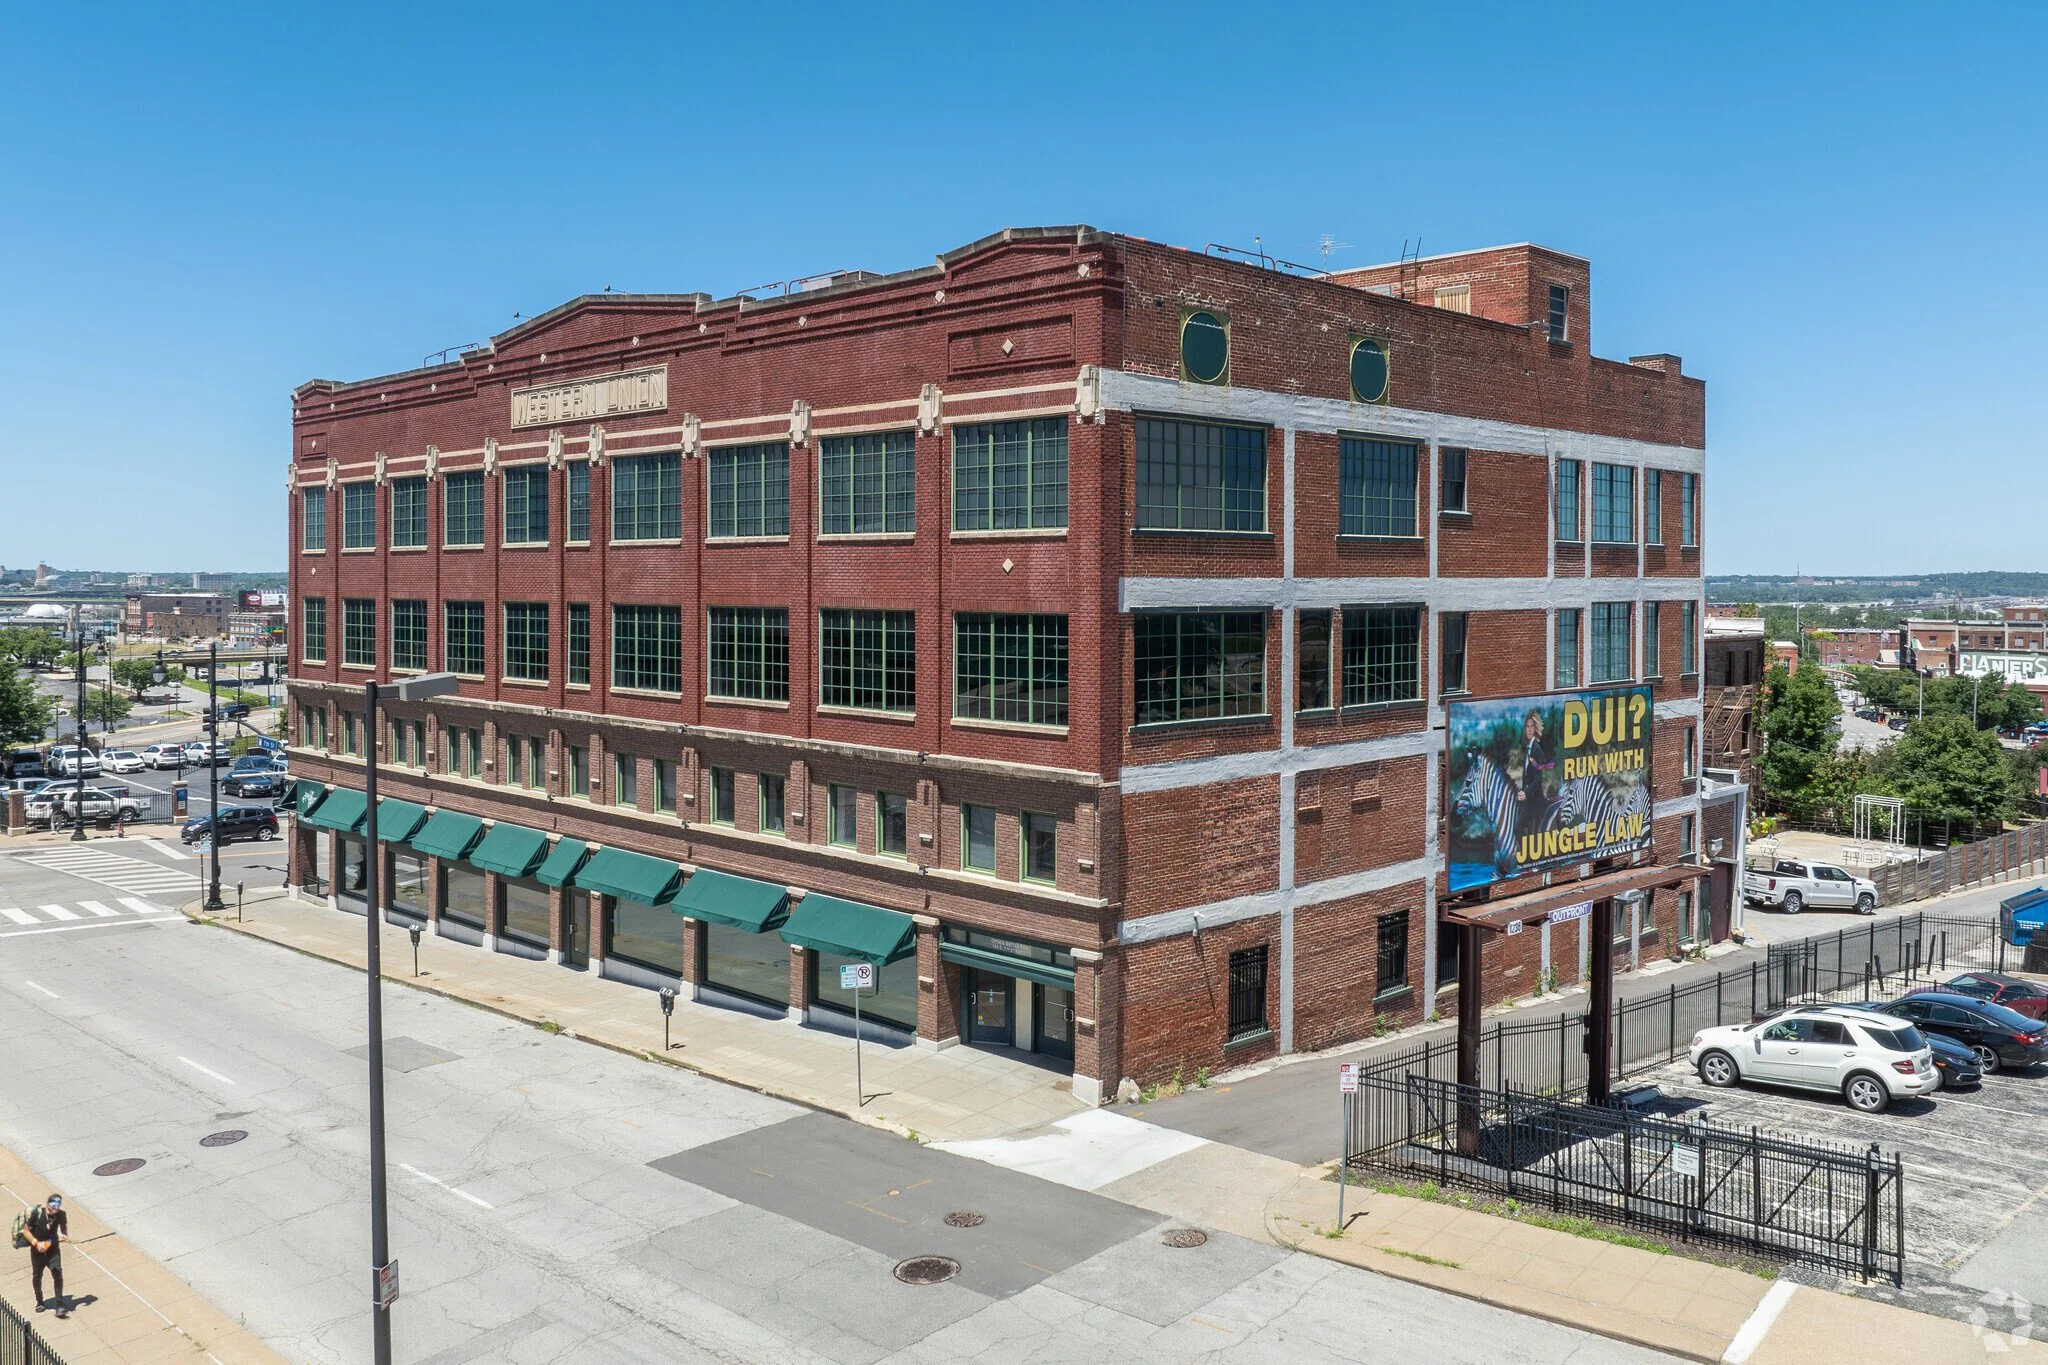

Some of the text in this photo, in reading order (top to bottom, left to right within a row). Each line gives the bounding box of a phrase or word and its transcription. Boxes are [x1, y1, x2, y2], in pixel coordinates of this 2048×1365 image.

[513, 371, 665, 425] WESTERN UNION
[1563, 694, 1647, 749] DUI?
[1564, 748, 1645, 780] RUN WITH
[1516, 826, 1597, 864] JUNGLE
[1604, 813, 1644, 844] LAW
[1552, 903, 1589, 922] OUTFRONT
